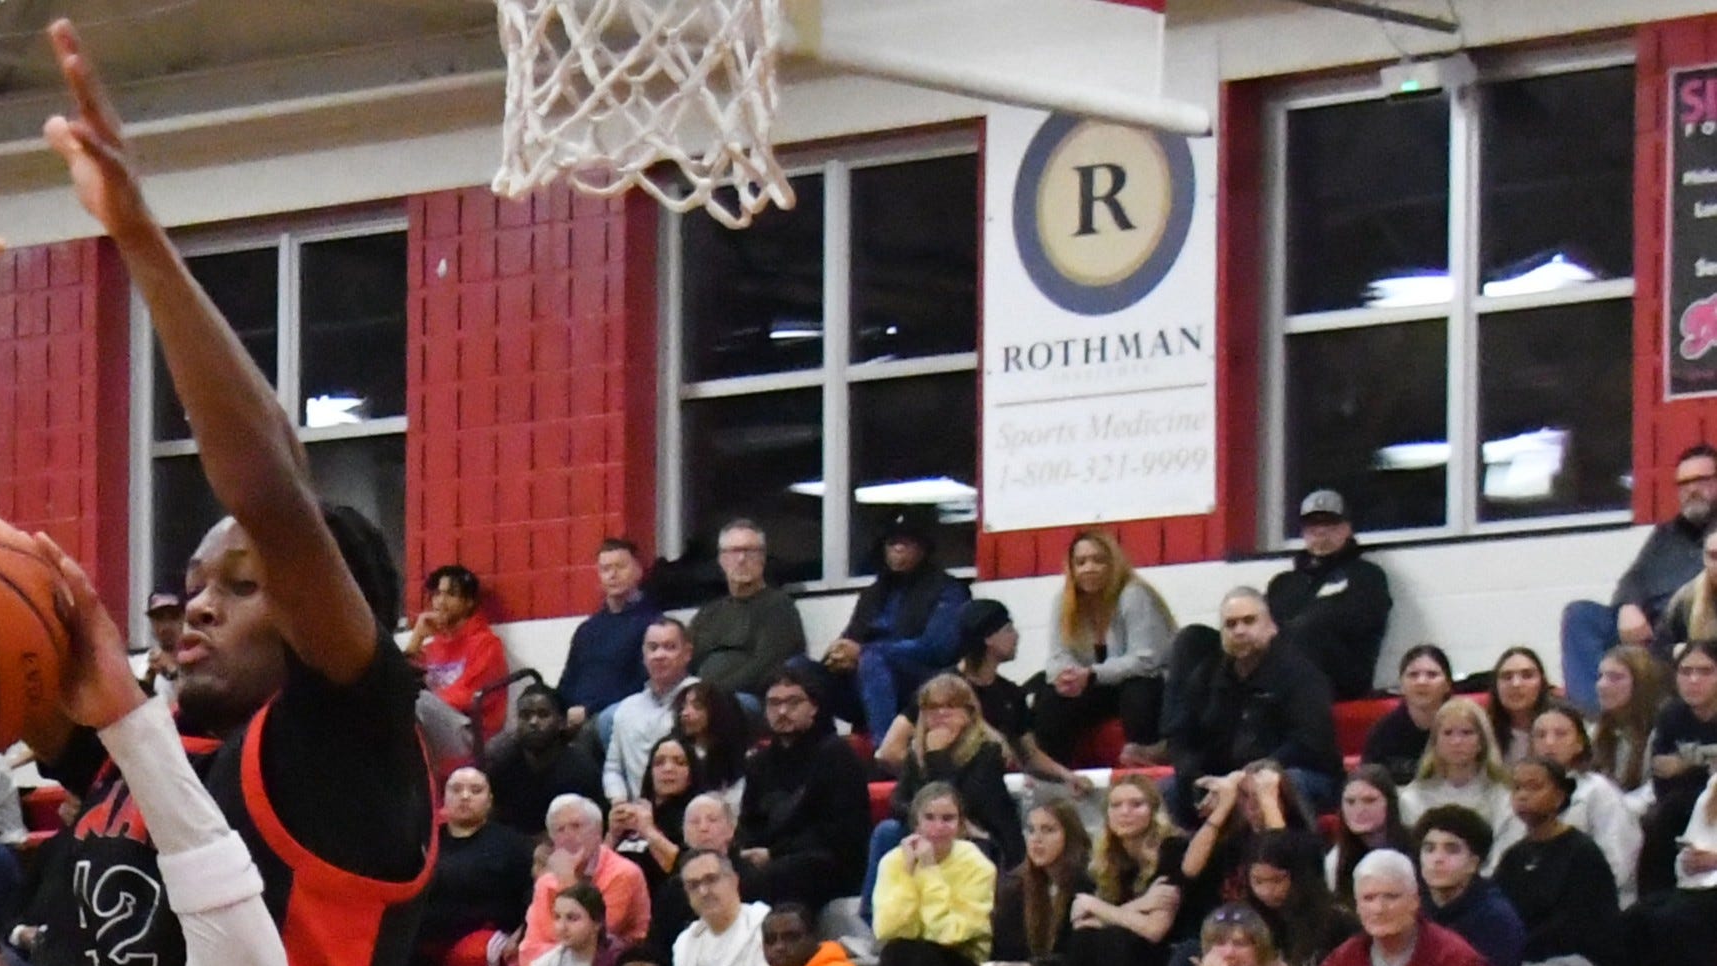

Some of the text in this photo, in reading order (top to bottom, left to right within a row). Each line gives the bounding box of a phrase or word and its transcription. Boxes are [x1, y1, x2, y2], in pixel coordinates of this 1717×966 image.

[1071, 163, 1137, 237] R
[1003, 325, 1203, 373] ROTHMAN
[995, 409, 1207, 455] Sports Medicine
[998, 446, 1209, 490] 1-800-321-9999
